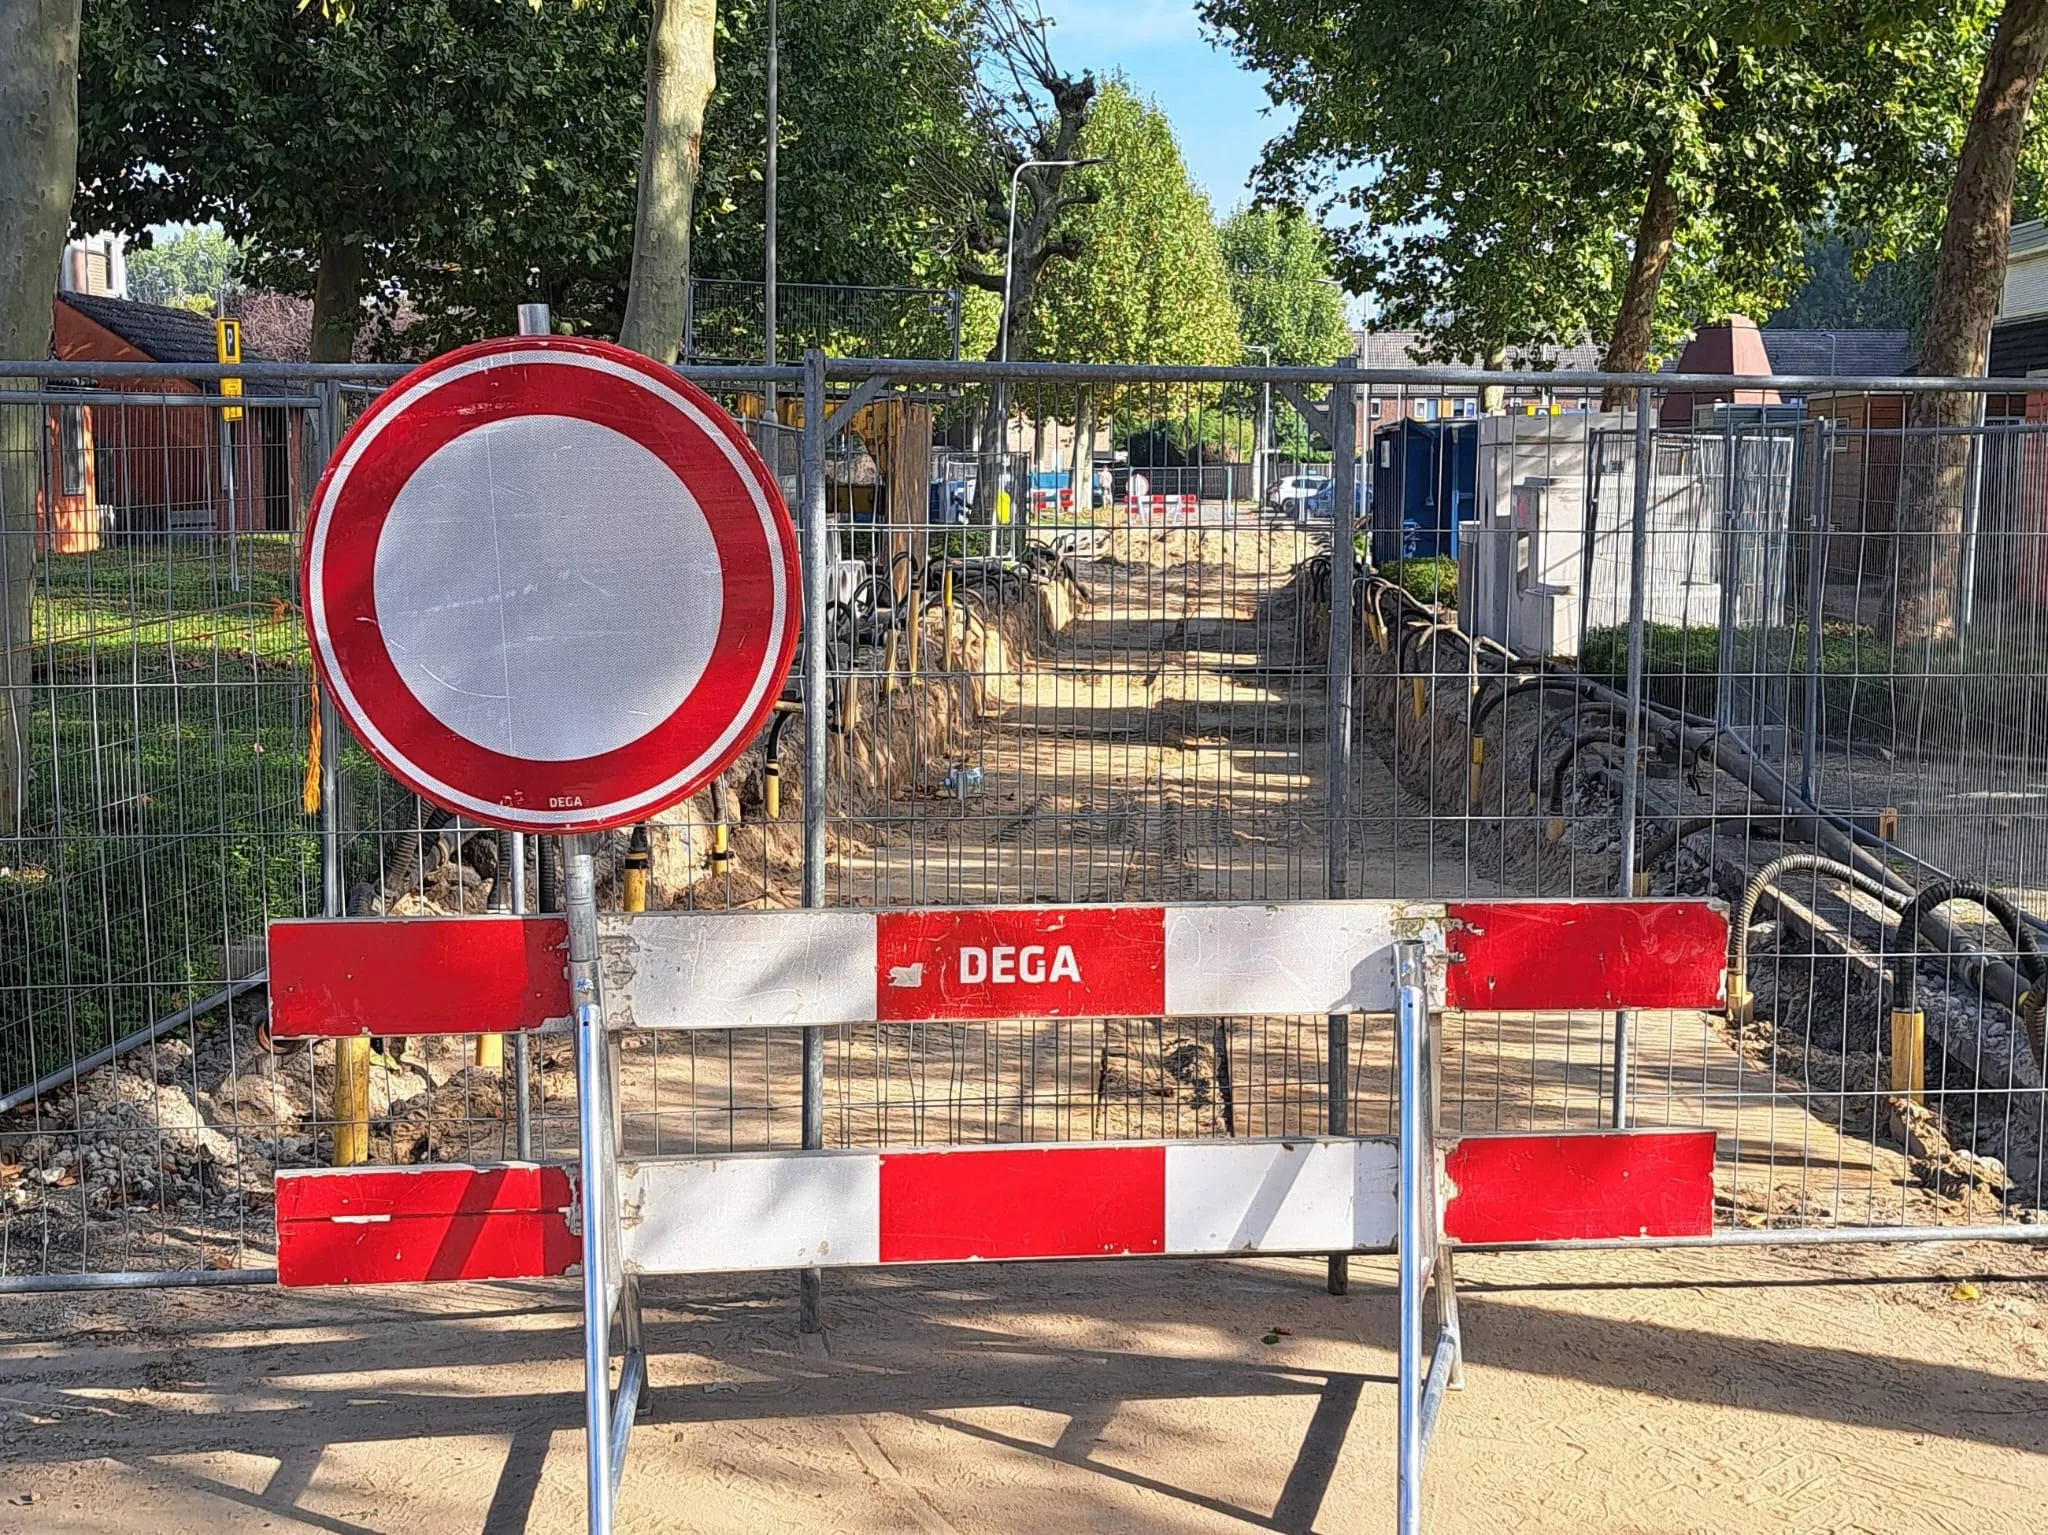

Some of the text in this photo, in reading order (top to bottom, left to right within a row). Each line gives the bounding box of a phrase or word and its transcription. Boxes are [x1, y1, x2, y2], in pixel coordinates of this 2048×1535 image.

[226, 327, 234, 353] P
[549, 796, 583, 808] DEGA
[959, 945, 1081, 984] DEGA
